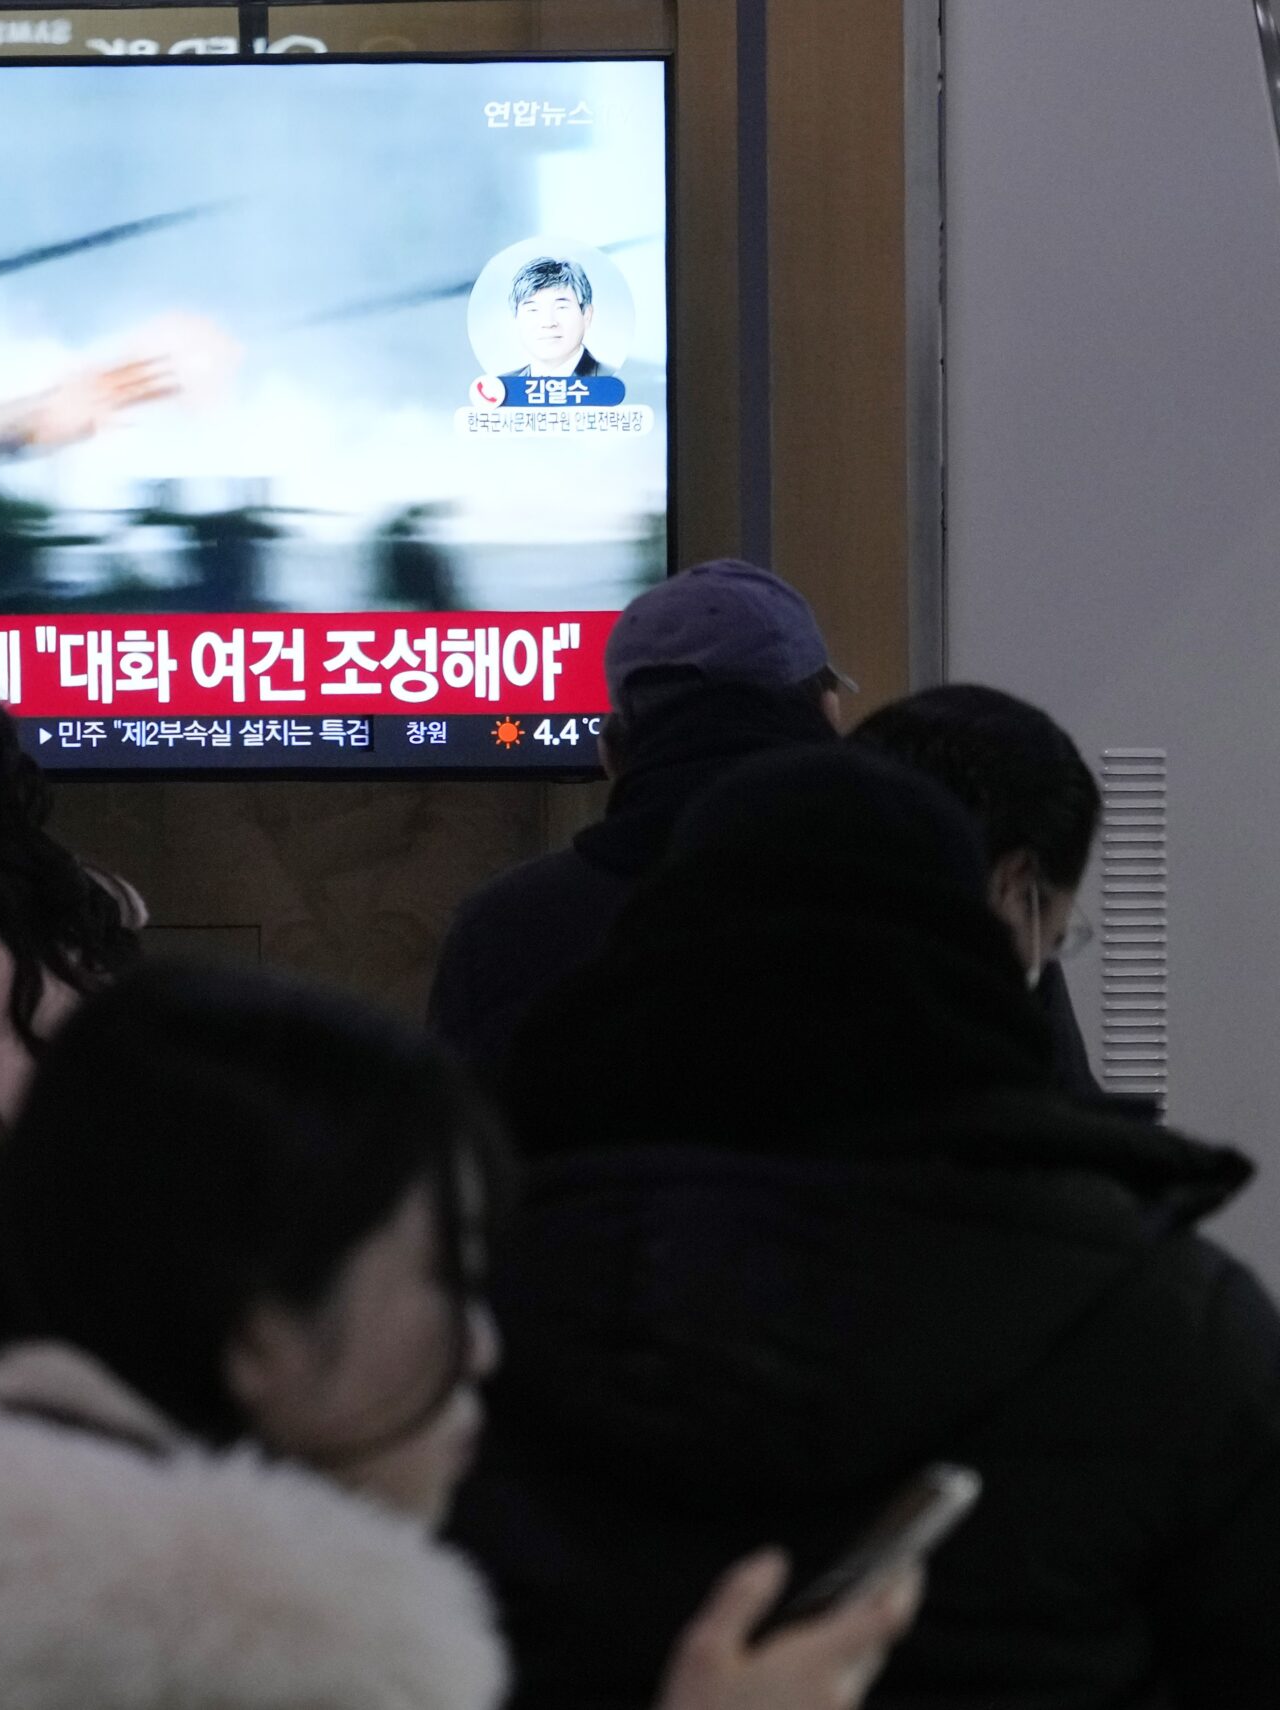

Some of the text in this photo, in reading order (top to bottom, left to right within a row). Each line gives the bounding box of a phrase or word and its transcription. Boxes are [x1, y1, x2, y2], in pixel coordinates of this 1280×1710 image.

[525, 379, 590, 405] 김열수
[35, 623, 178, 704] "대화
[190, 628, 306, 702] 여건
[321, 622, 581, 703] 조성해야"
[58, 718, 370, 749] 민주 "제2부속실 설치는 특검
[405, 720, 448, 745] 창원
